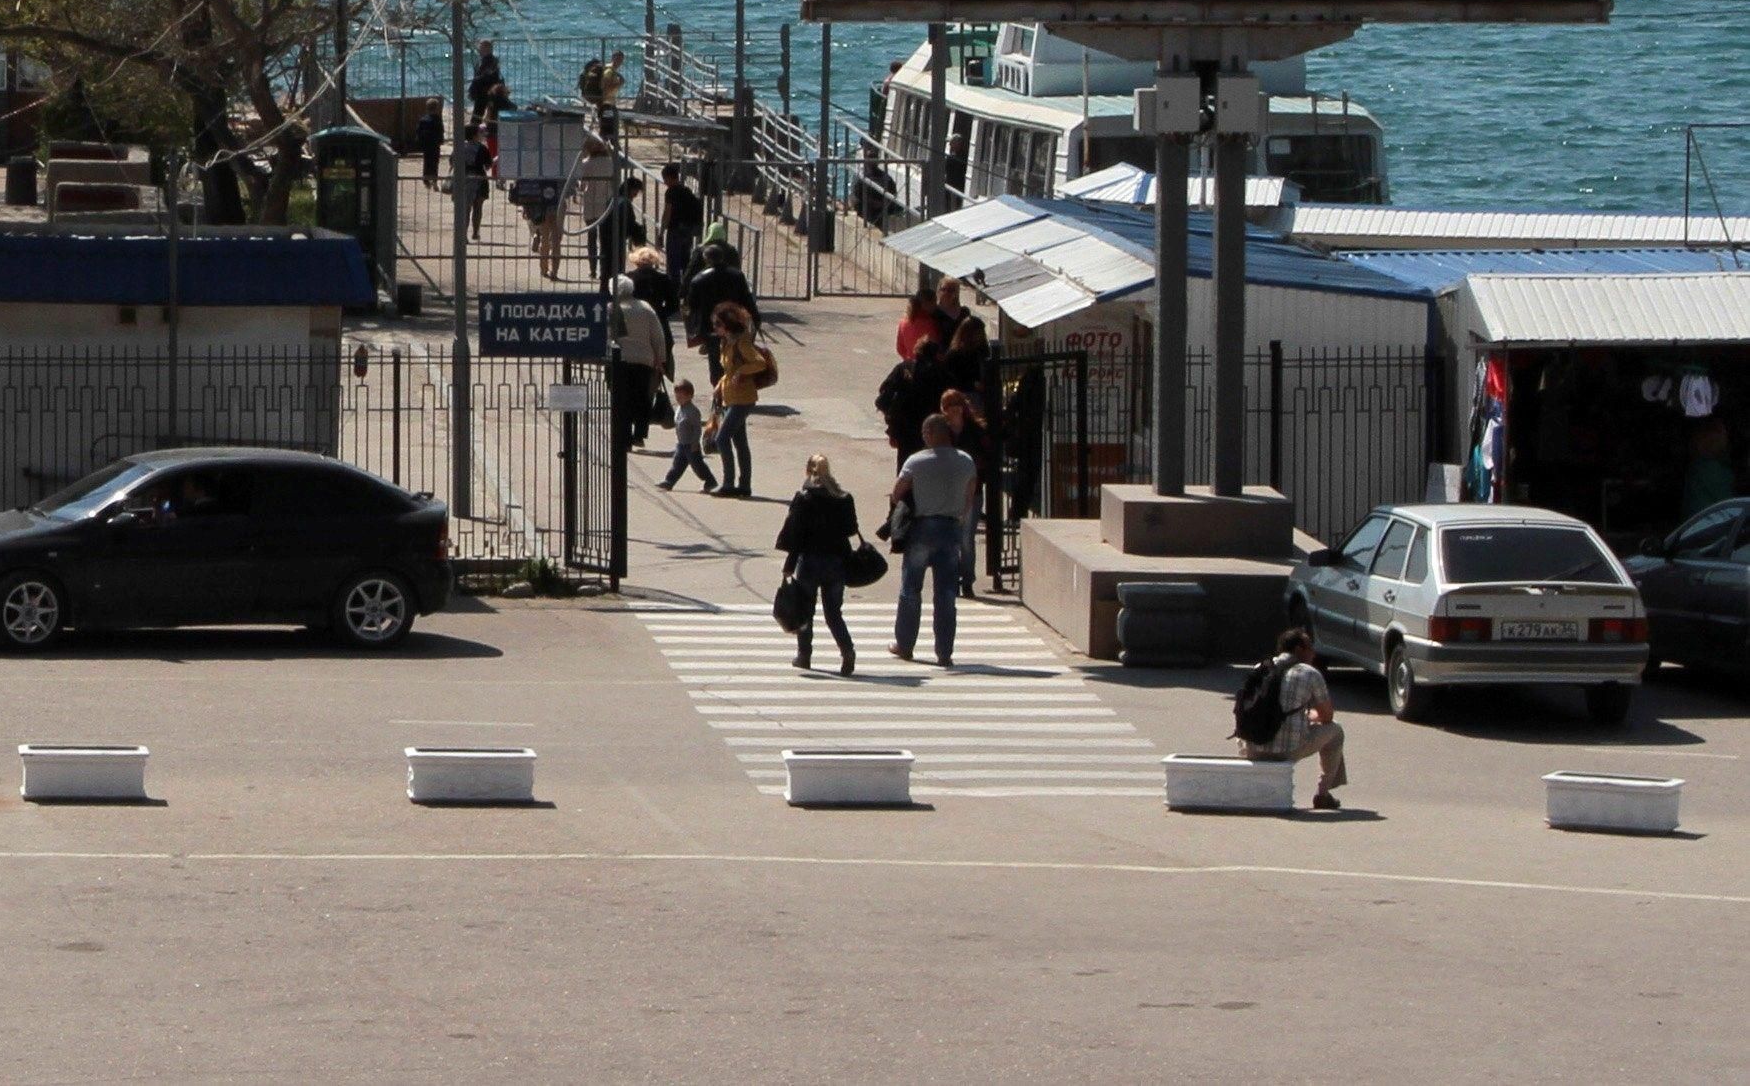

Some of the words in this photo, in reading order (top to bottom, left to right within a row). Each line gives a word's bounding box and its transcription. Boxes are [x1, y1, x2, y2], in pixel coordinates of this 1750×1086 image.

[500, 304, 586, 321] ПОСАДКА
[496, 327, 520, 342] НА
[529, 327, 590, 342] КАТЕР
[1066, 331, 1123, 348] ФОТО
